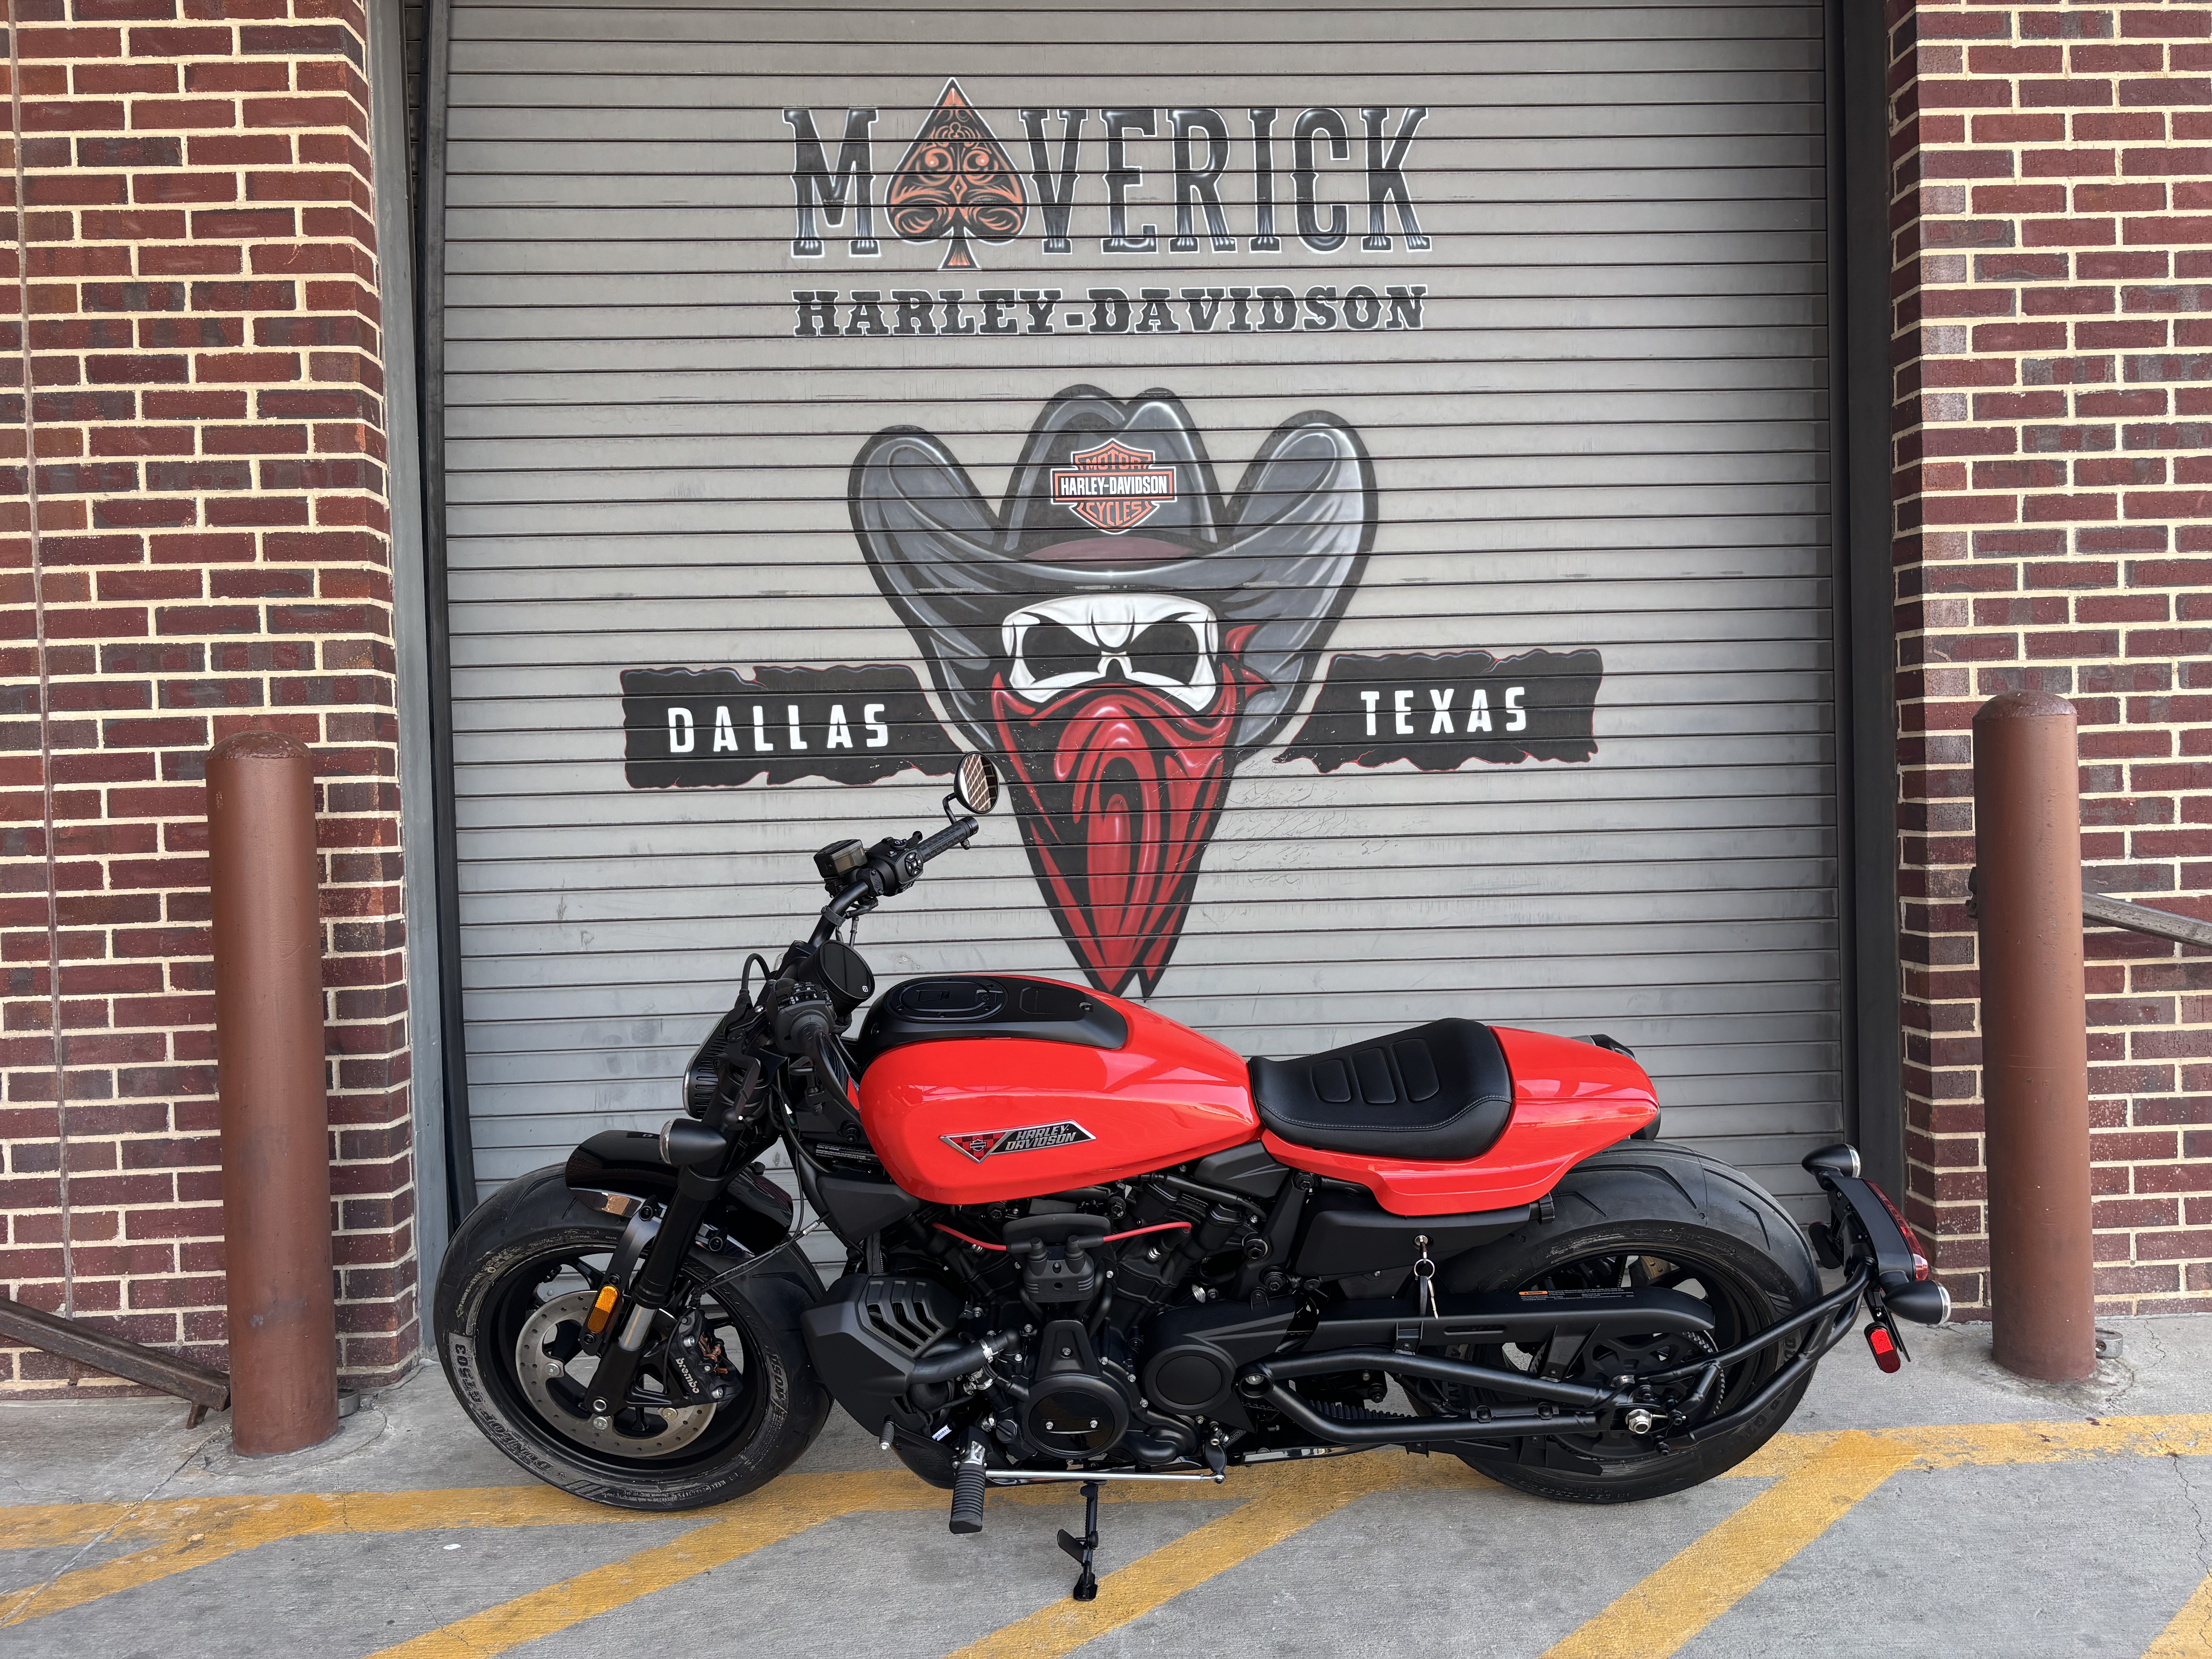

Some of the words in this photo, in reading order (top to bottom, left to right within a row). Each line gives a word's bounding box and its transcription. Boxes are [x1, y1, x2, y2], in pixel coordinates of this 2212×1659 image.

[791, 285, 1427, 337] HARLEY-DAVIDSON
[1086, 449, 1141, 470] MOTOR
[1061, 476, 1167, 495] HARLEY-DAVIDSON
[1086, 501, 1142, 526] CYCLES
[668, 704, 888, 753] DALLAS
[1360, 687, 1526, 736] TEXAS
[1005, 1132, 1077, 1151] DAVIDSON
[675, 1357, 700, 1394] brembo
[480, 1410, 555, 1471] DUNLOP
